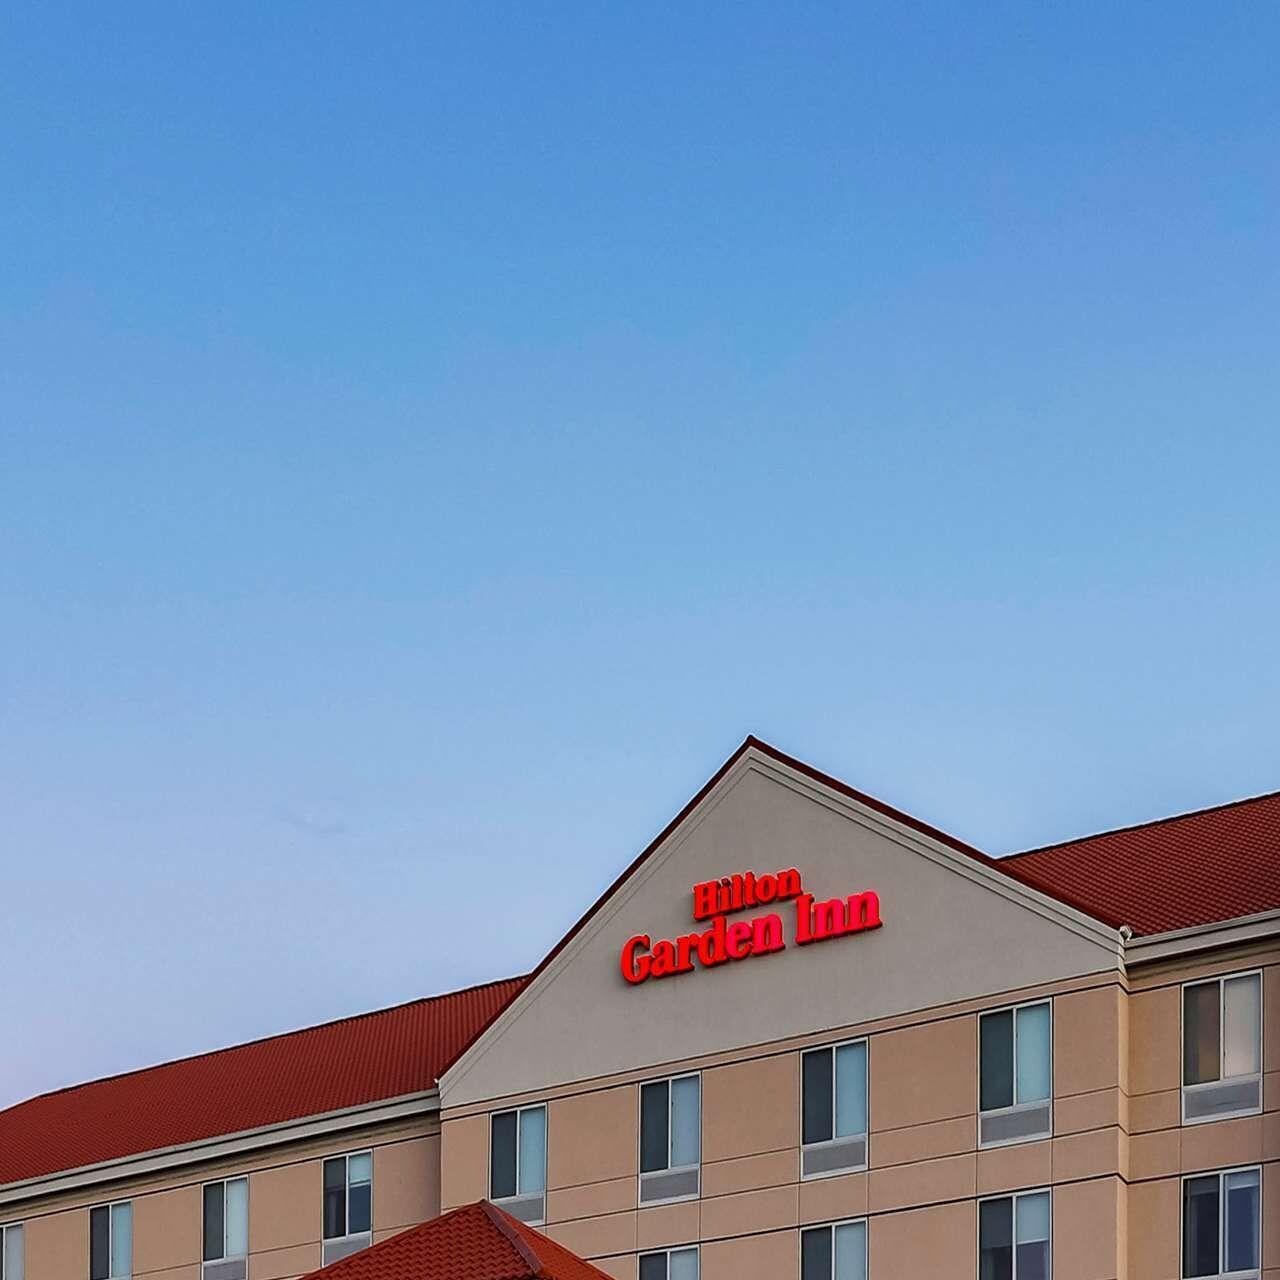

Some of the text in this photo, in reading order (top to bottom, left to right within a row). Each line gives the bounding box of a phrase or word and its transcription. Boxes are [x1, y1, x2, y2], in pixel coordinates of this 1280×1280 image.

[693, 867, 804, 921] Hilton
[621, 889, 883, 985] Garden Inn
